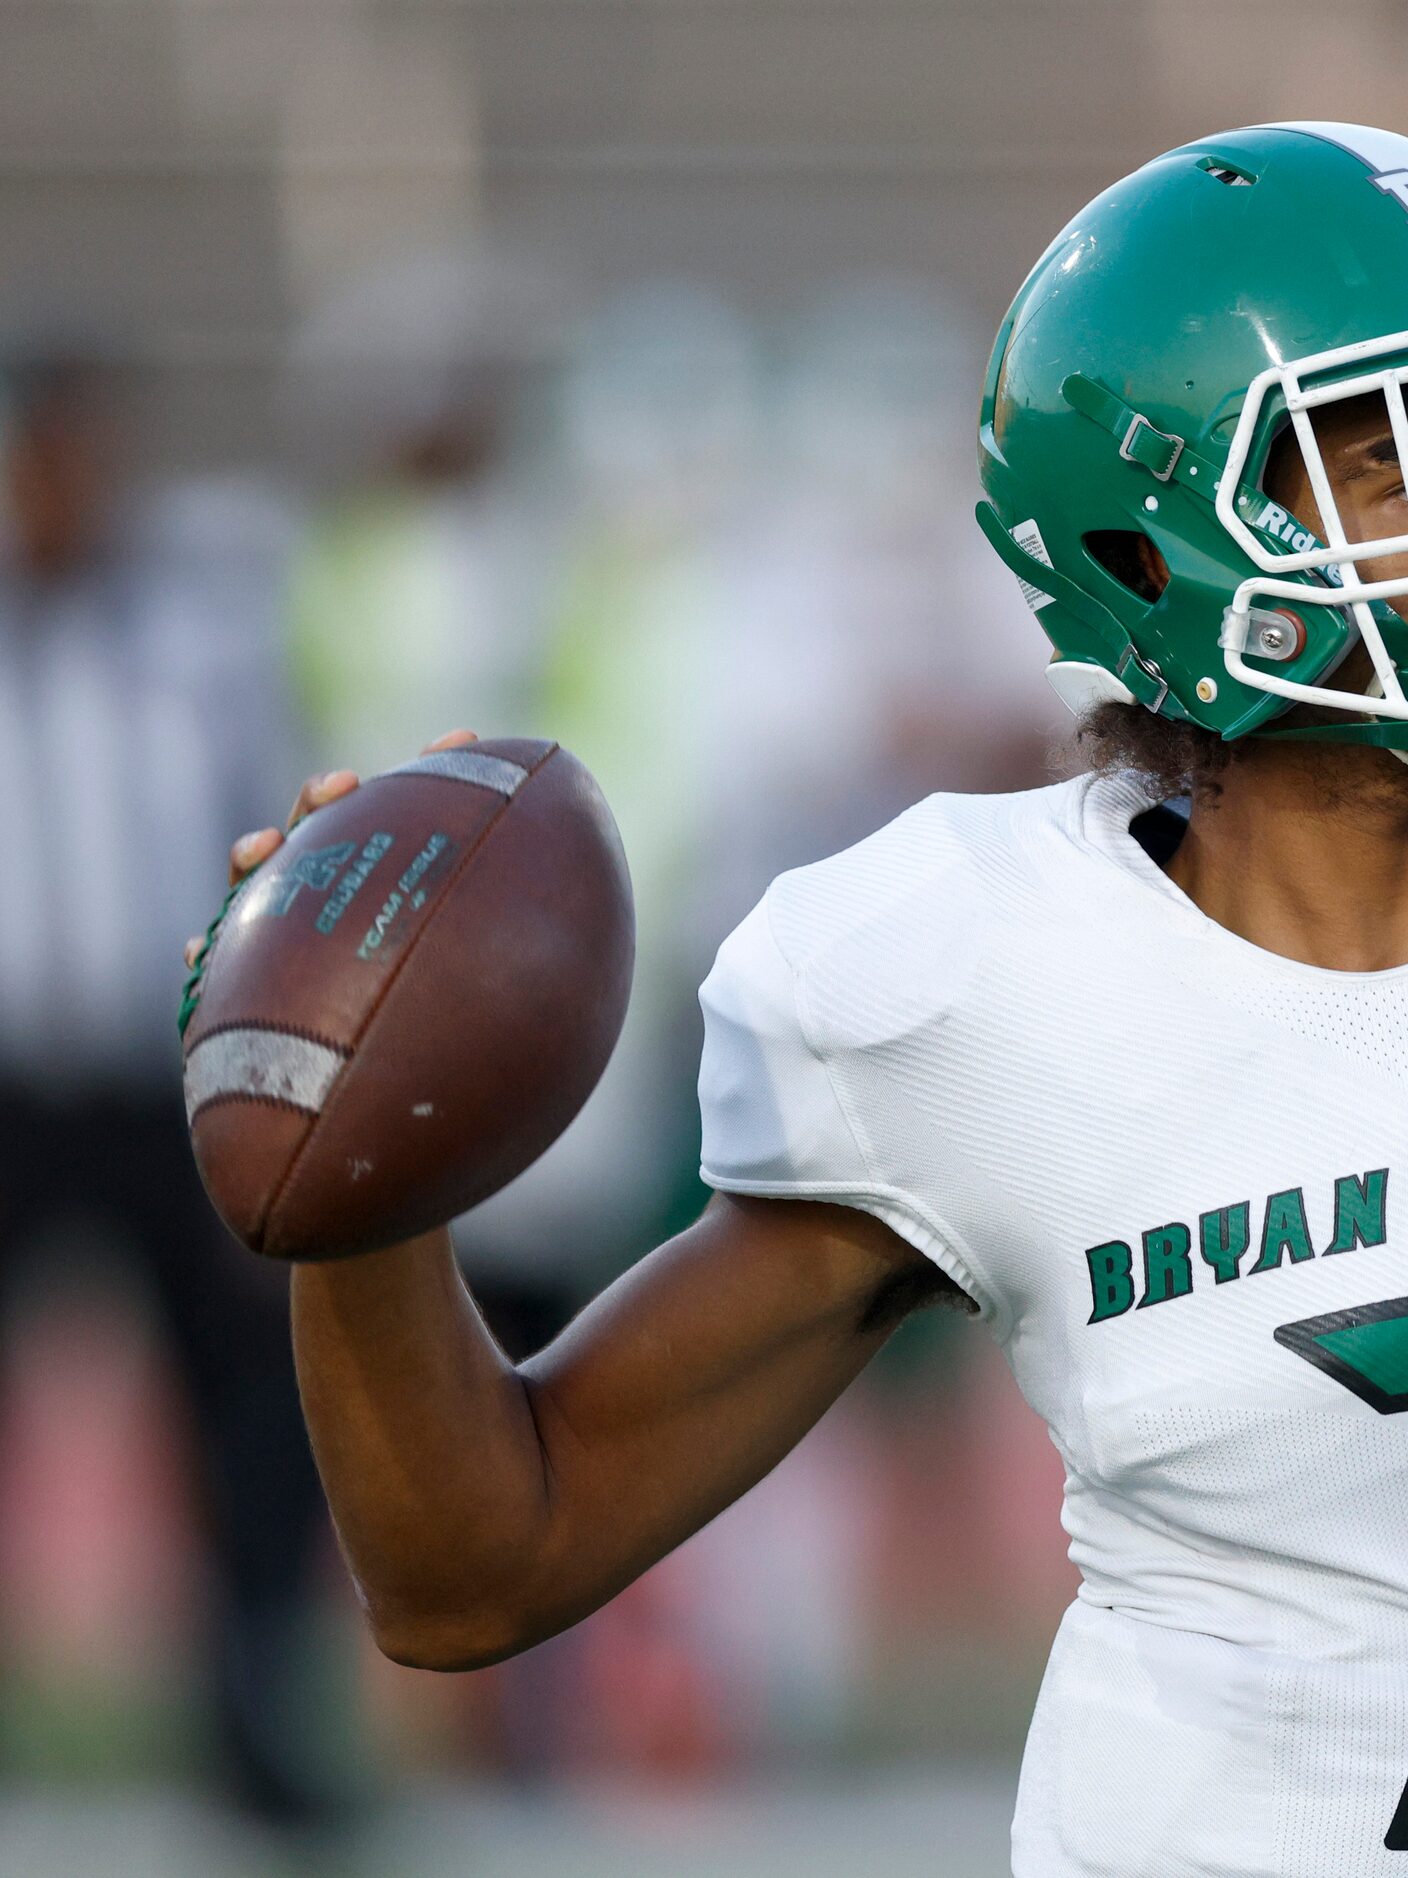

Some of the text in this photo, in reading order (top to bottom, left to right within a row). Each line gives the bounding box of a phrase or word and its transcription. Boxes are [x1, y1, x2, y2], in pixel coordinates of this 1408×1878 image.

[1255, 502, 1343, 586] Ride
[356, 892, 402, 960] TEAM
[1085, 1168, 1389, 1325] BRYAN
